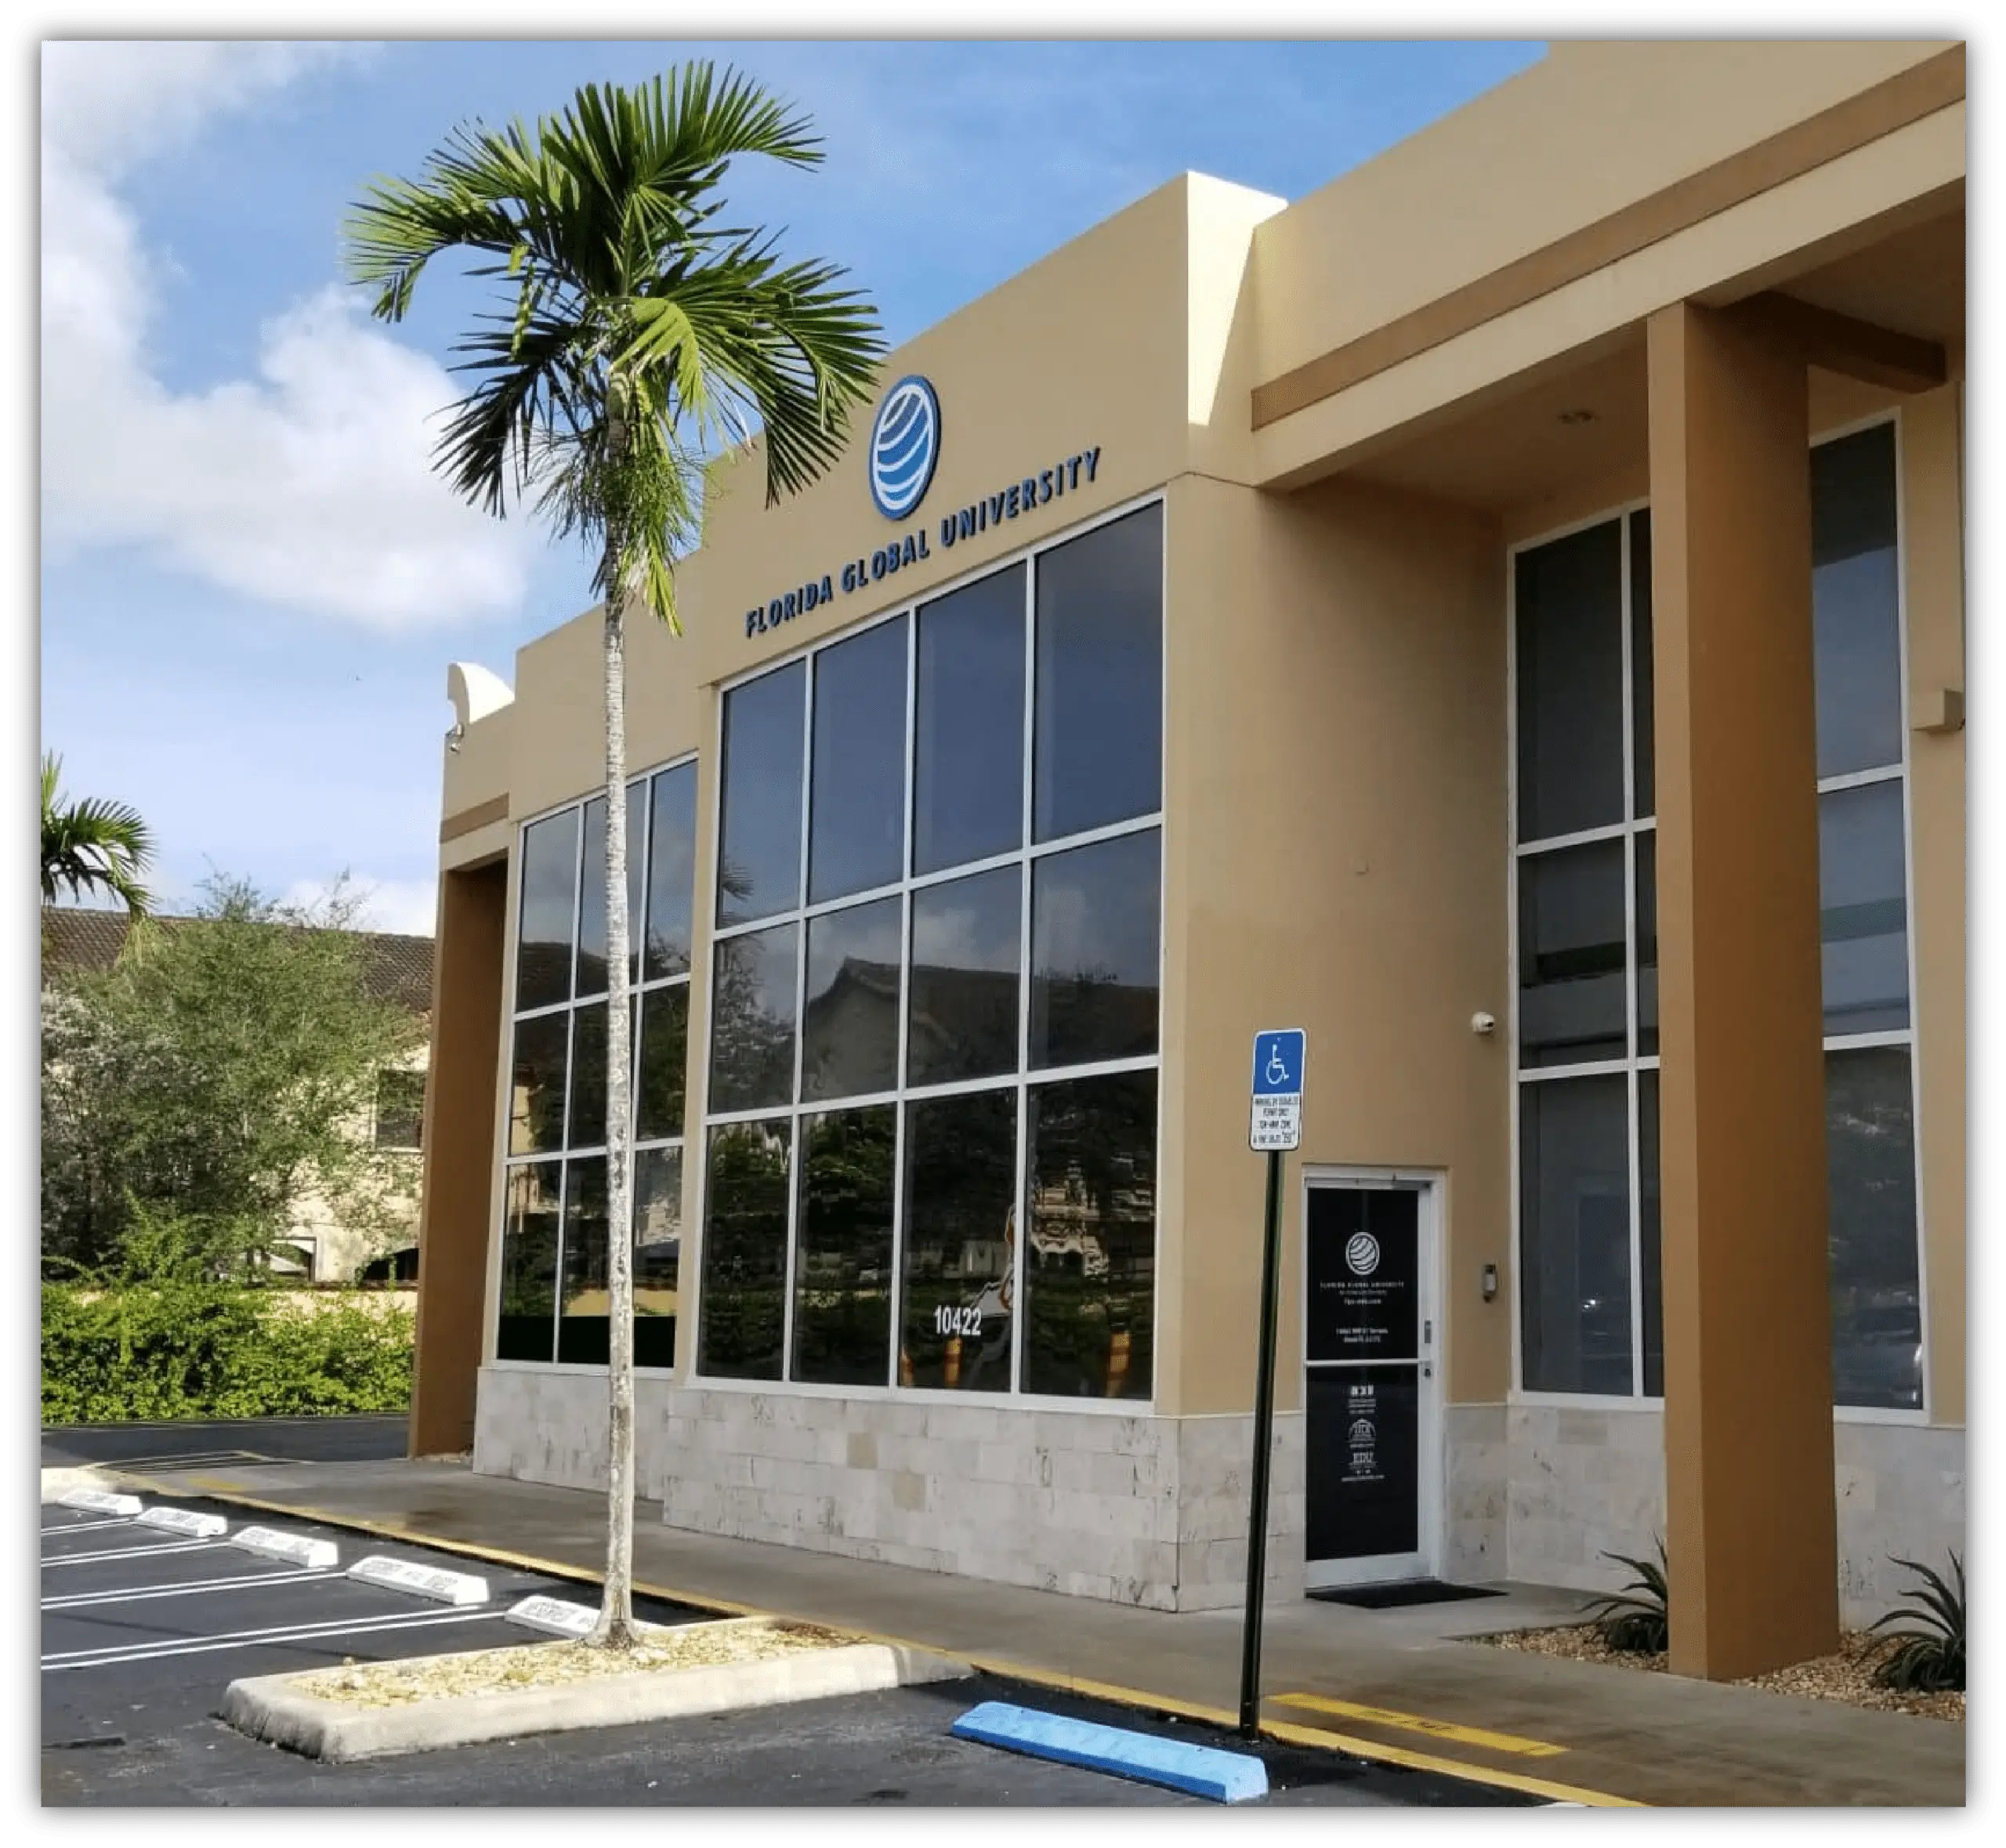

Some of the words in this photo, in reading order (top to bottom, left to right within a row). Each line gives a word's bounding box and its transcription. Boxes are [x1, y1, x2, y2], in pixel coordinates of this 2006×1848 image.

[744, 575, 834, 638] FLORIDA
[841, 529, 931, 594] GLOBAL
[940, 445, 1101, 548] UNIVERSITY
[933, 1304, 982, 1335] 10422
